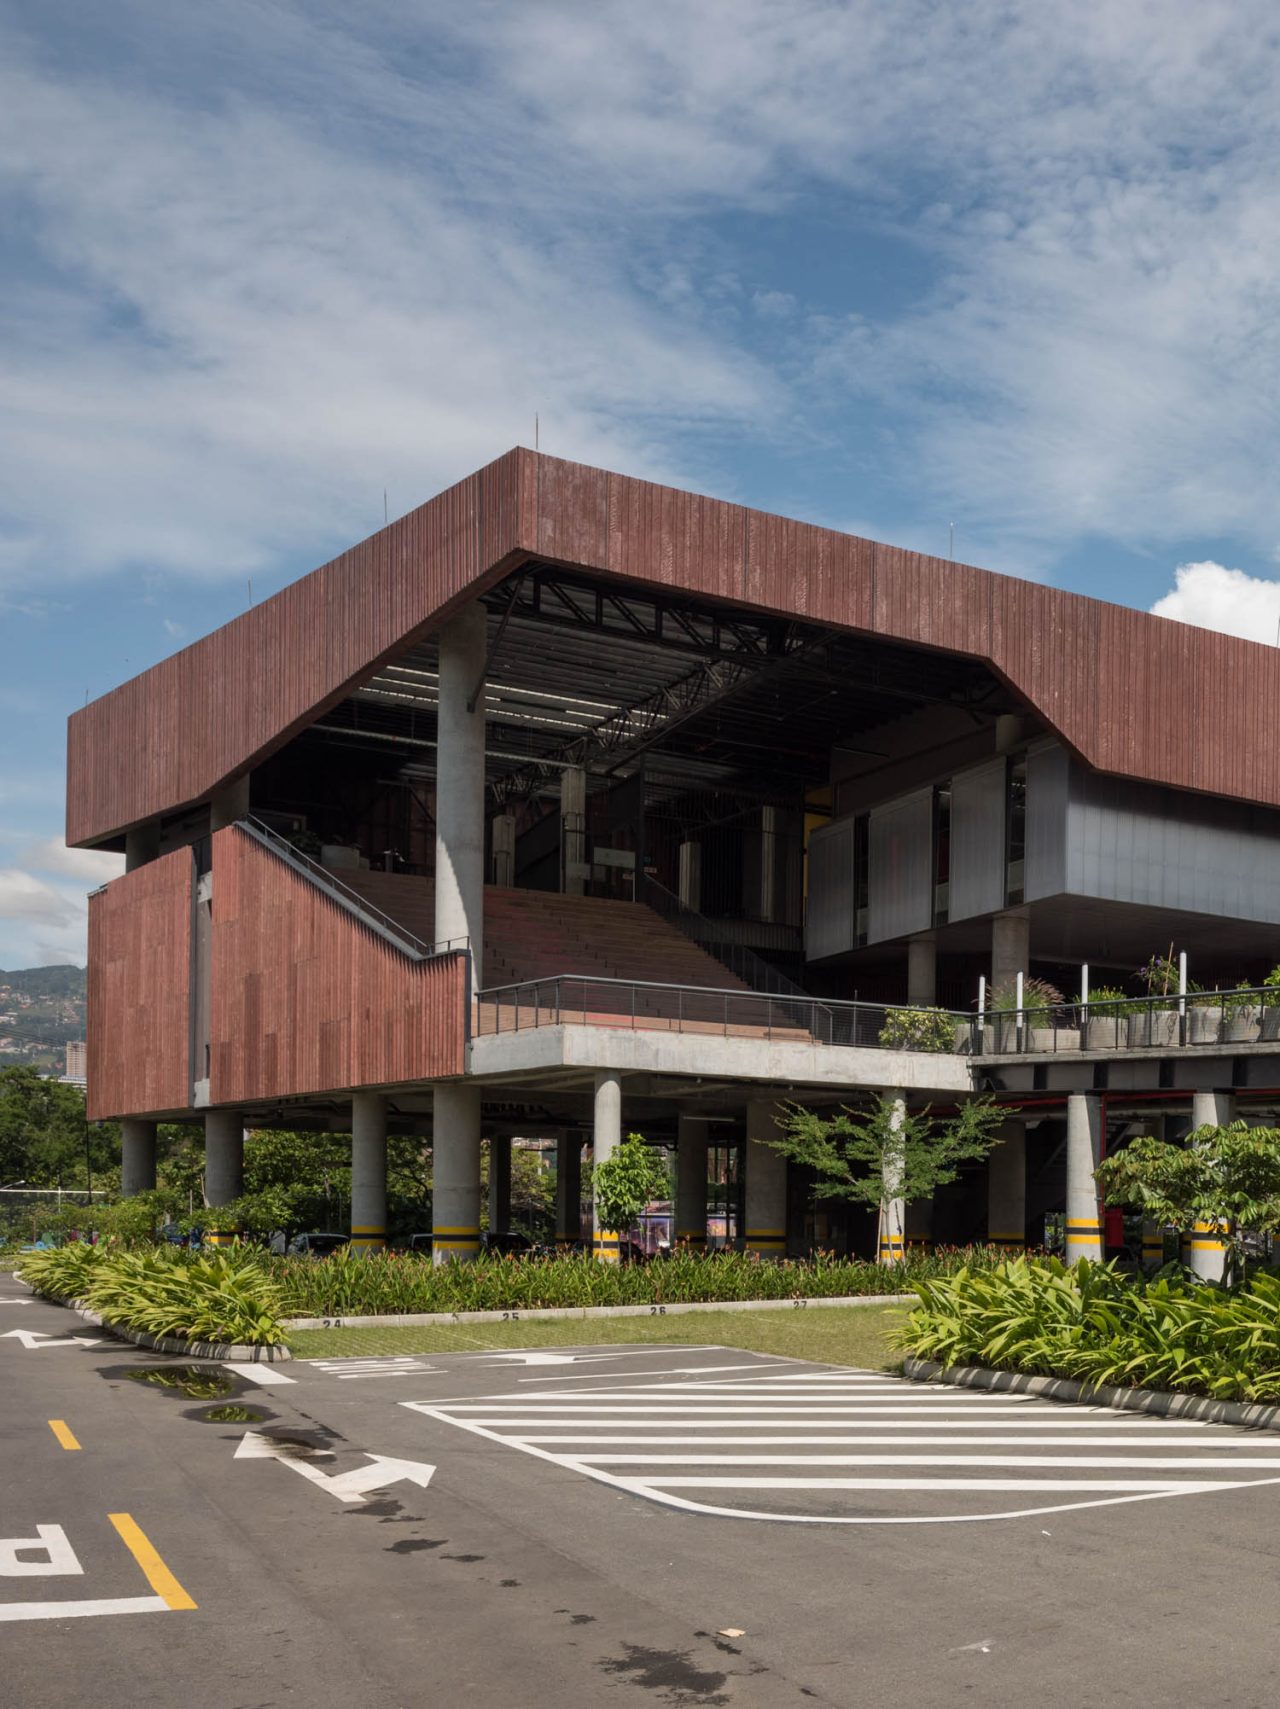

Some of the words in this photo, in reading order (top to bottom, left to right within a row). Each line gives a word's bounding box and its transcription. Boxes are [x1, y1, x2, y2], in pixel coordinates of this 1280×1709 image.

[650, 1306, 666, 1316] 26
[502, 1312, 519, 1321] 25
[322, 1319, 341, 1329] 24
